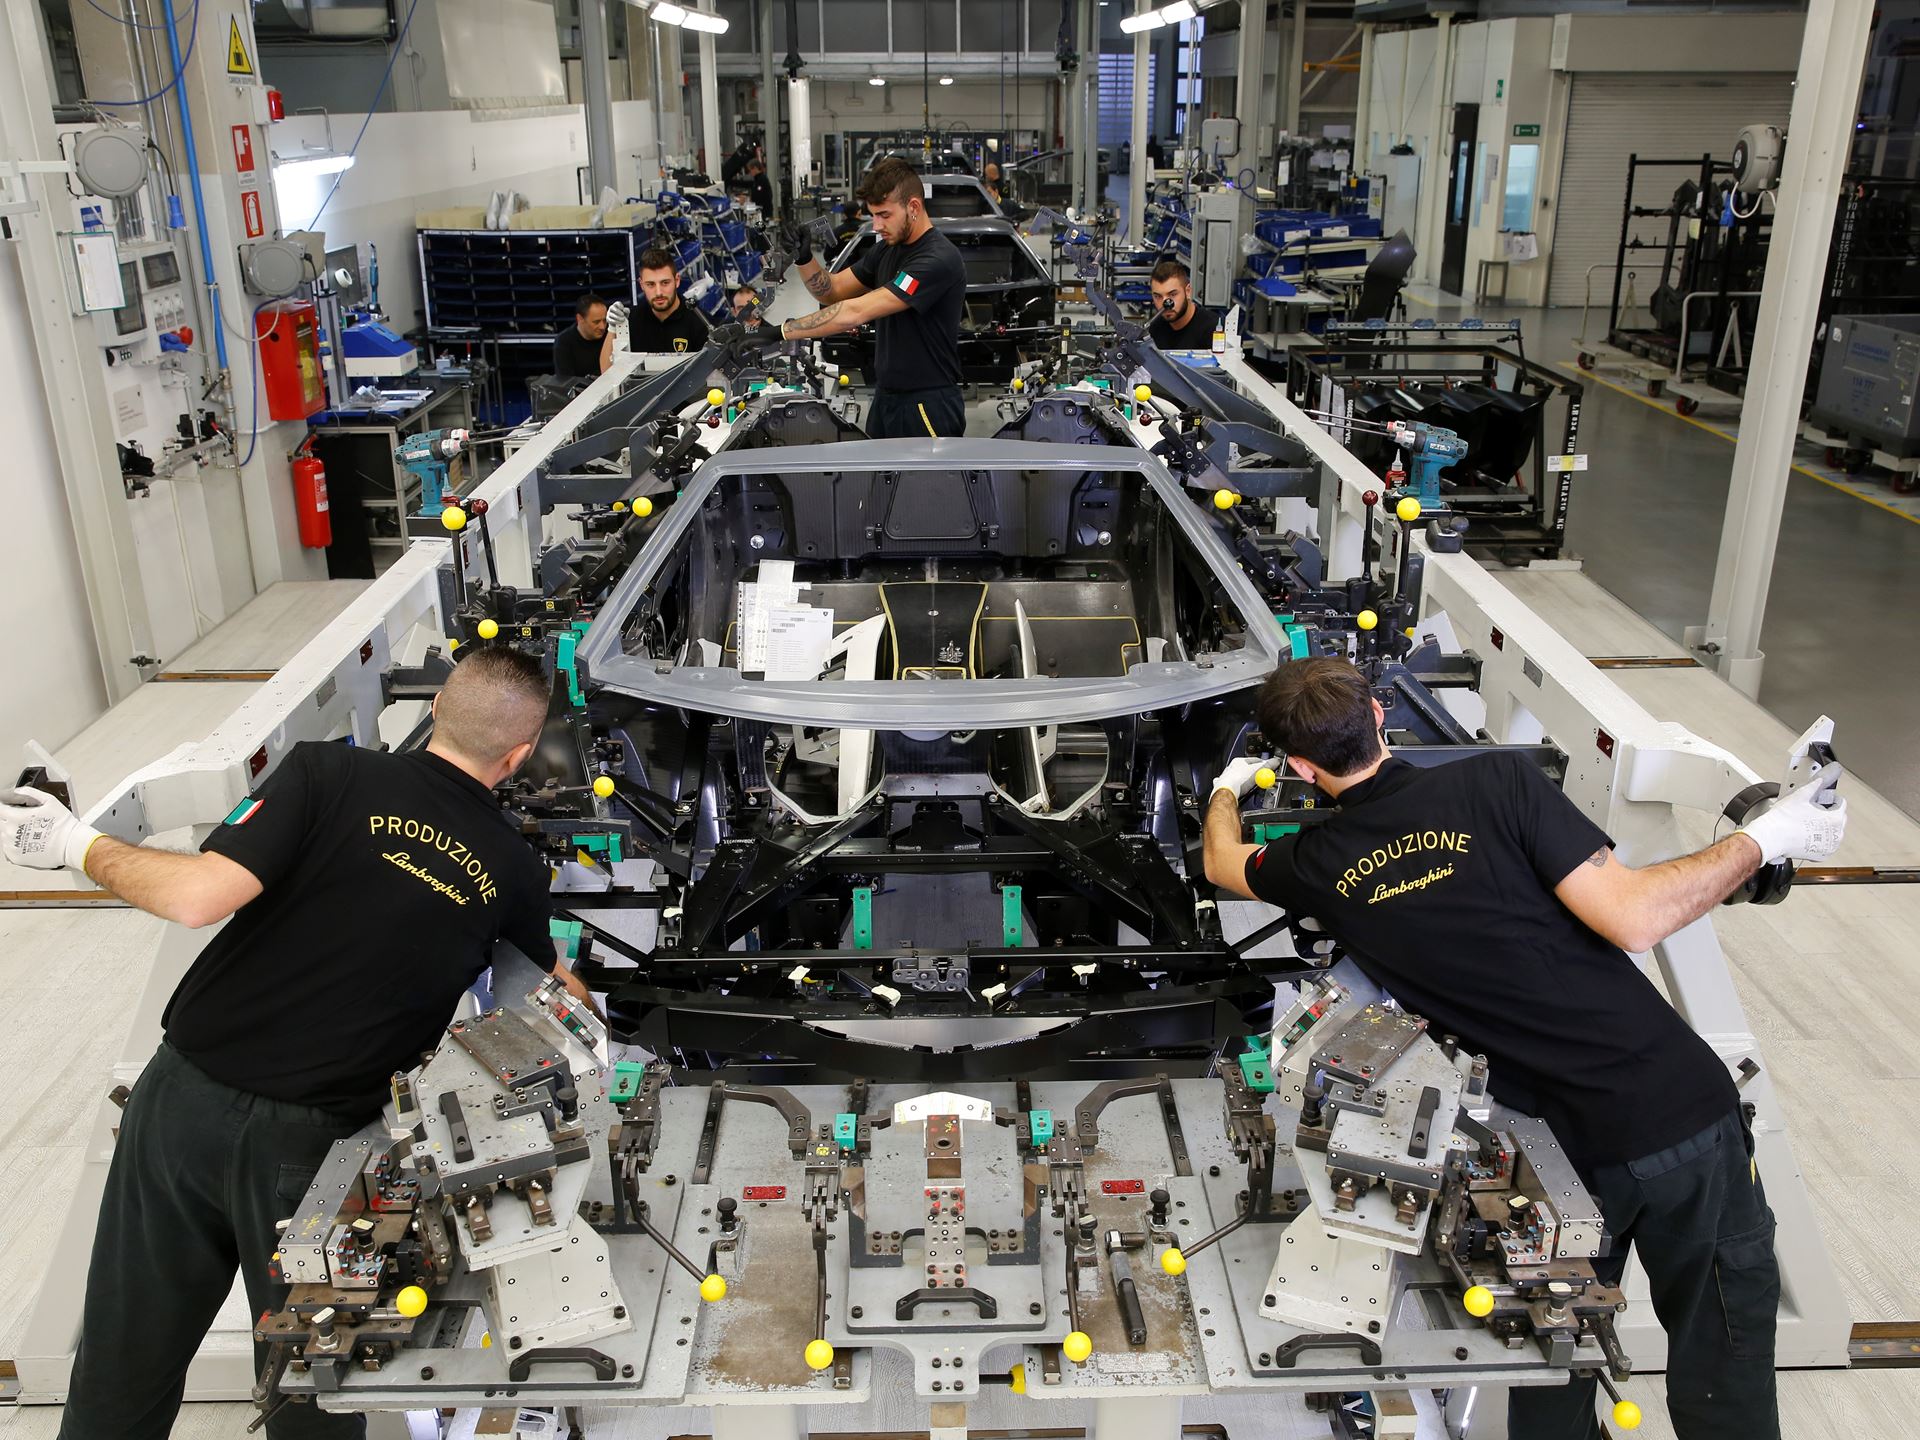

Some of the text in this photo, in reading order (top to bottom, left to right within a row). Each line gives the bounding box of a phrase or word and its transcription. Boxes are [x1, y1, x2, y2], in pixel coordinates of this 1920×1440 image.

[369, 815, 497, 904] PRODUZIONE
[382, 852, 470, 905] Lamborghini
[1336, 831, 1472, 898] PRODUZIONE
[1367, 862, 1454, 904] Lamborghini
